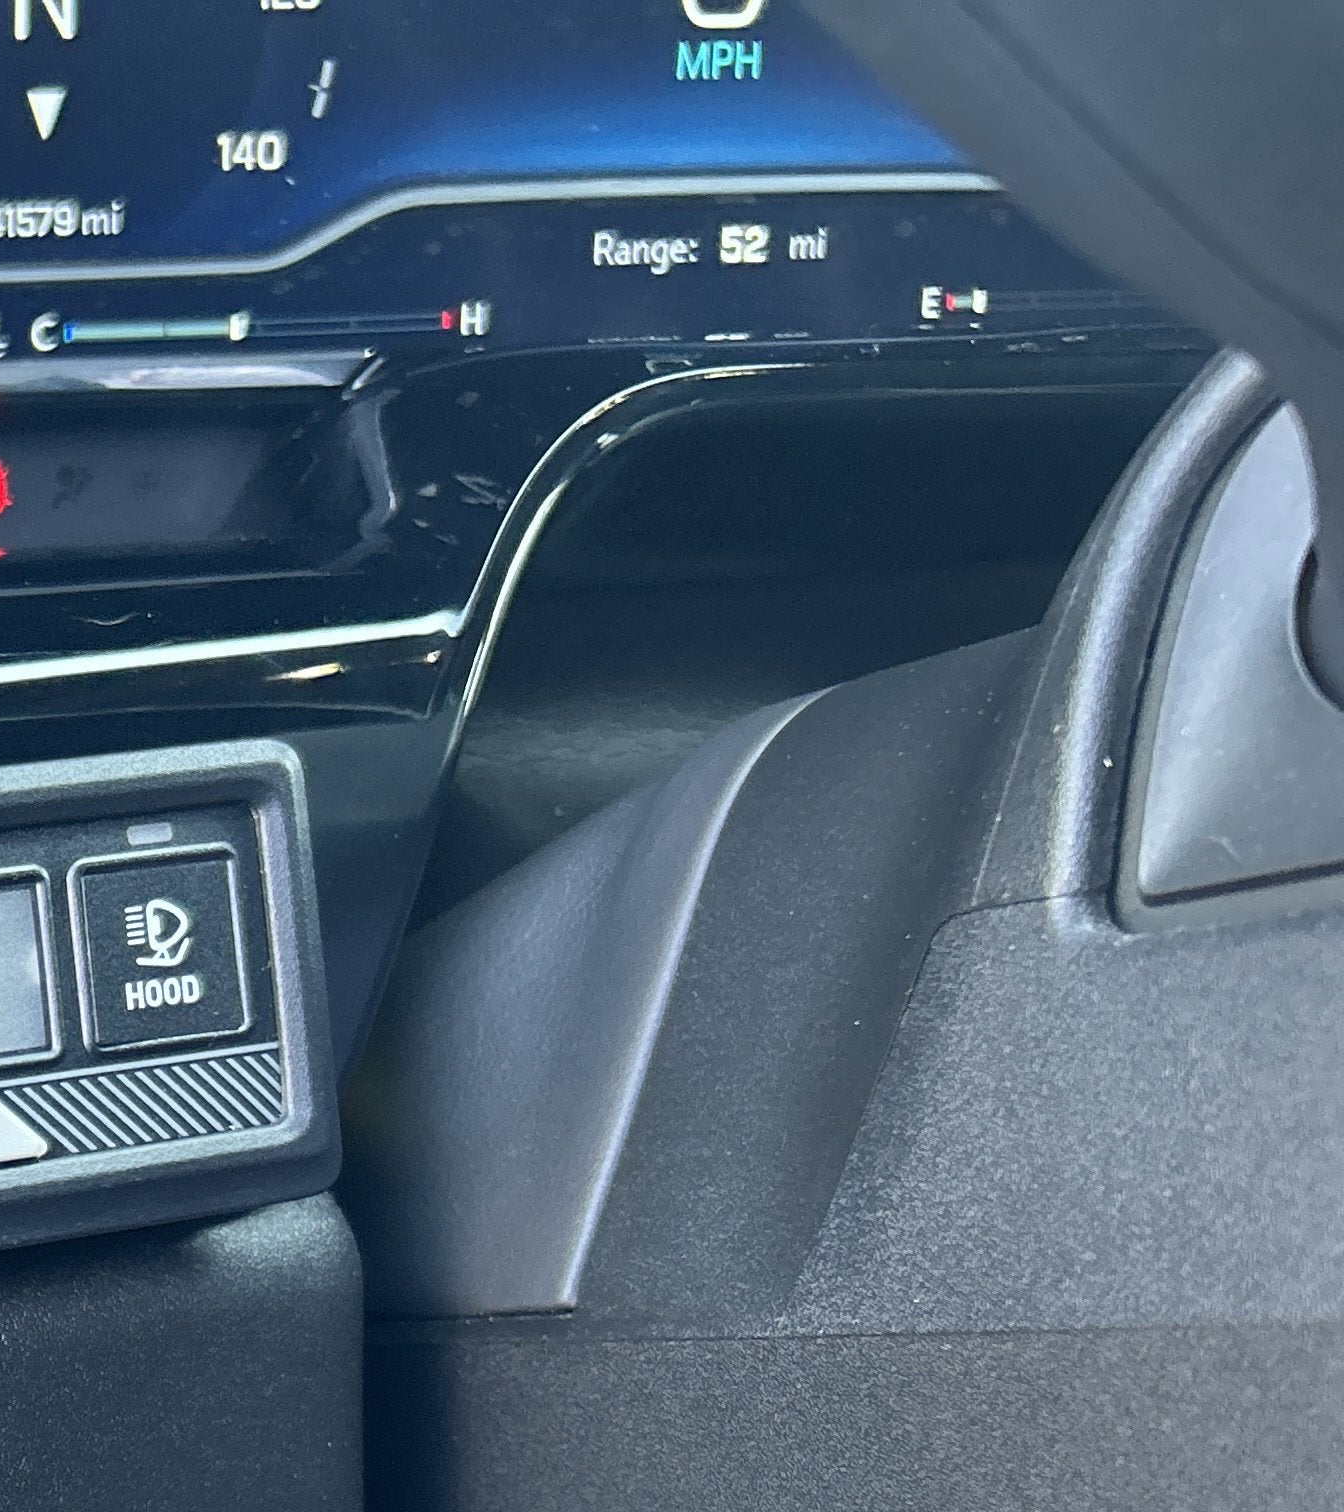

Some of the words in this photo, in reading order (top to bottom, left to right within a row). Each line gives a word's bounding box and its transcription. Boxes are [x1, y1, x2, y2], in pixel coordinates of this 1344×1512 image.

[674, 40, 762, 81] MPH
[216, 130, 288, 171] 140
[81, 200, 125, 236] mi
[593, 230, 701, 275] Range:
[719, 222, 770, 264] 52
[789, 225, 828, 260] mi
[460, 300, 490, 337] H
[921, 285, 942, 319] E
[31, 311, 60, 352] C
[124, 974, 201, 1011] HOOD
